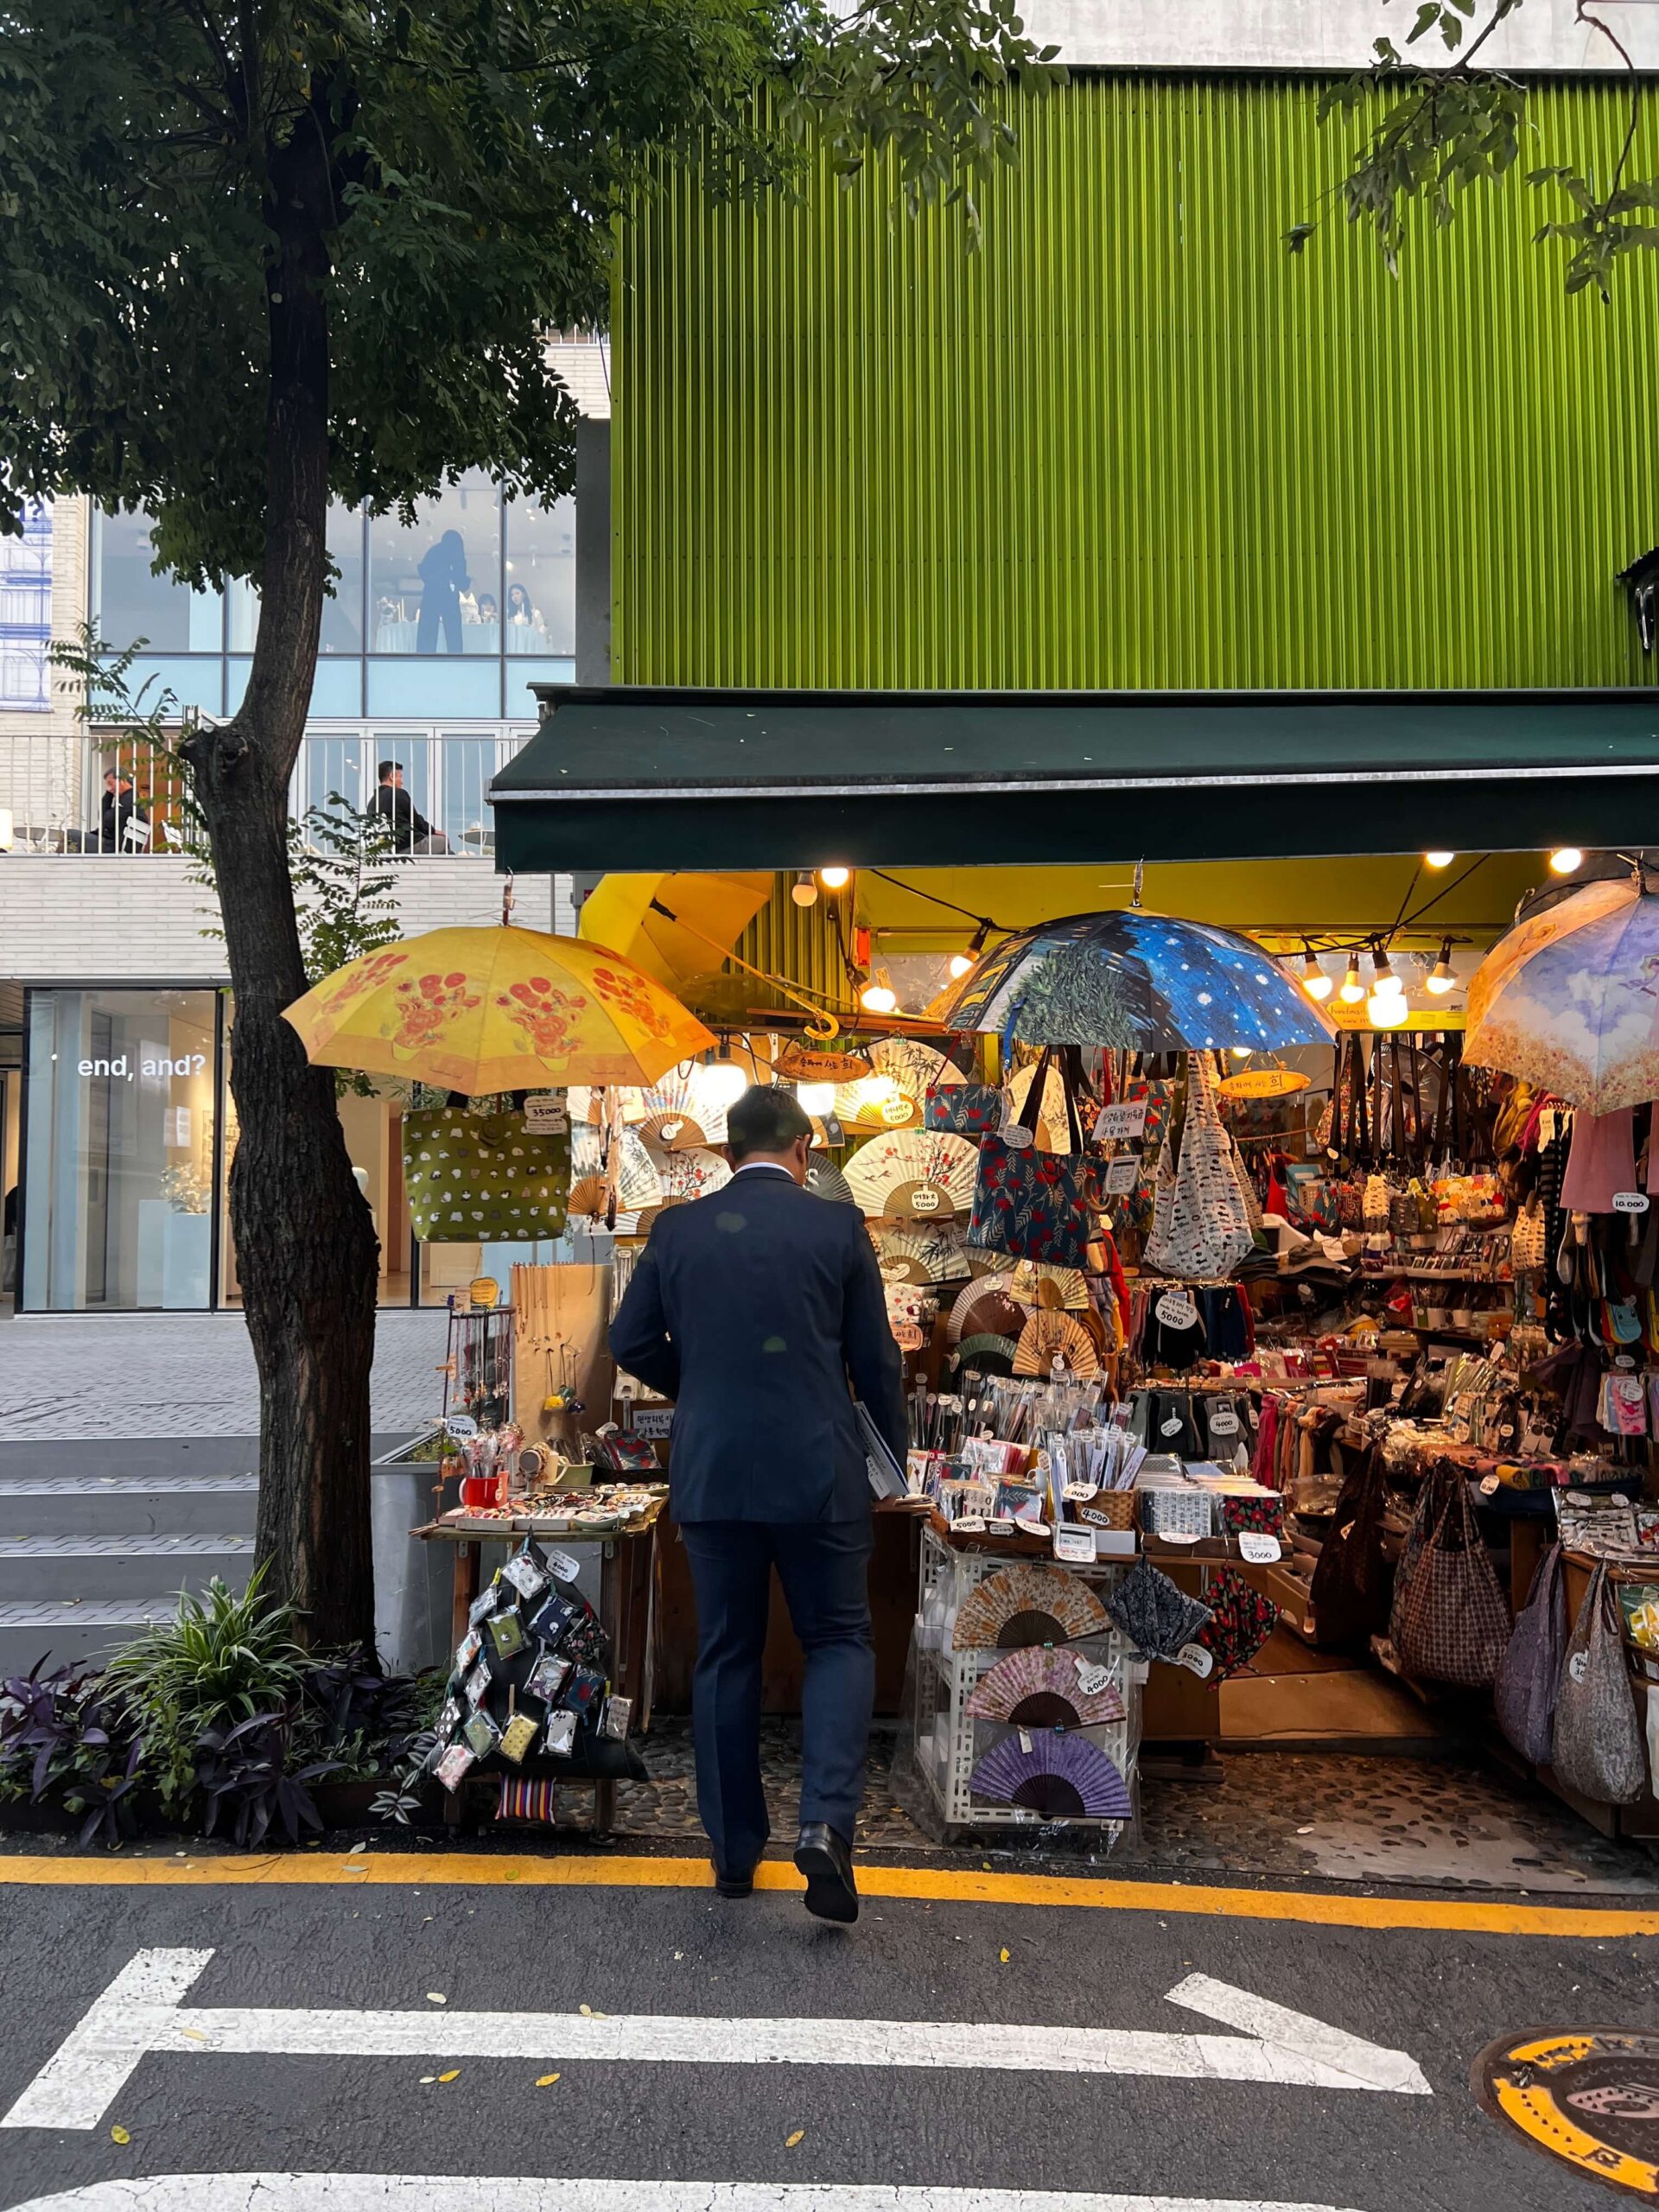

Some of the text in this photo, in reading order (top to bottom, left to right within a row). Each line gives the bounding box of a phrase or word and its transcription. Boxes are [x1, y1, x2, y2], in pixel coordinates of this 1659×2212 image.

[77, 1054, 206, 1082] end, and?
[1269, 1074, 1283, 1088] 희
[532, 1108, 562, 1117] 35000
[915, 1199, 936, 1208] 5000
[1160, 1309, 1184, 1325] 5000
[449, 1425, 472, 1436] 5000
[1082, 1508, 1109, 1523] 4000
[956, 1521, 976, 1529] 5000
[1247, 1551, 1272, 1560] 3000
[1181, 1651, 1204, 1667] 3000
[1087, 1675, 1109, 1694] 4000
